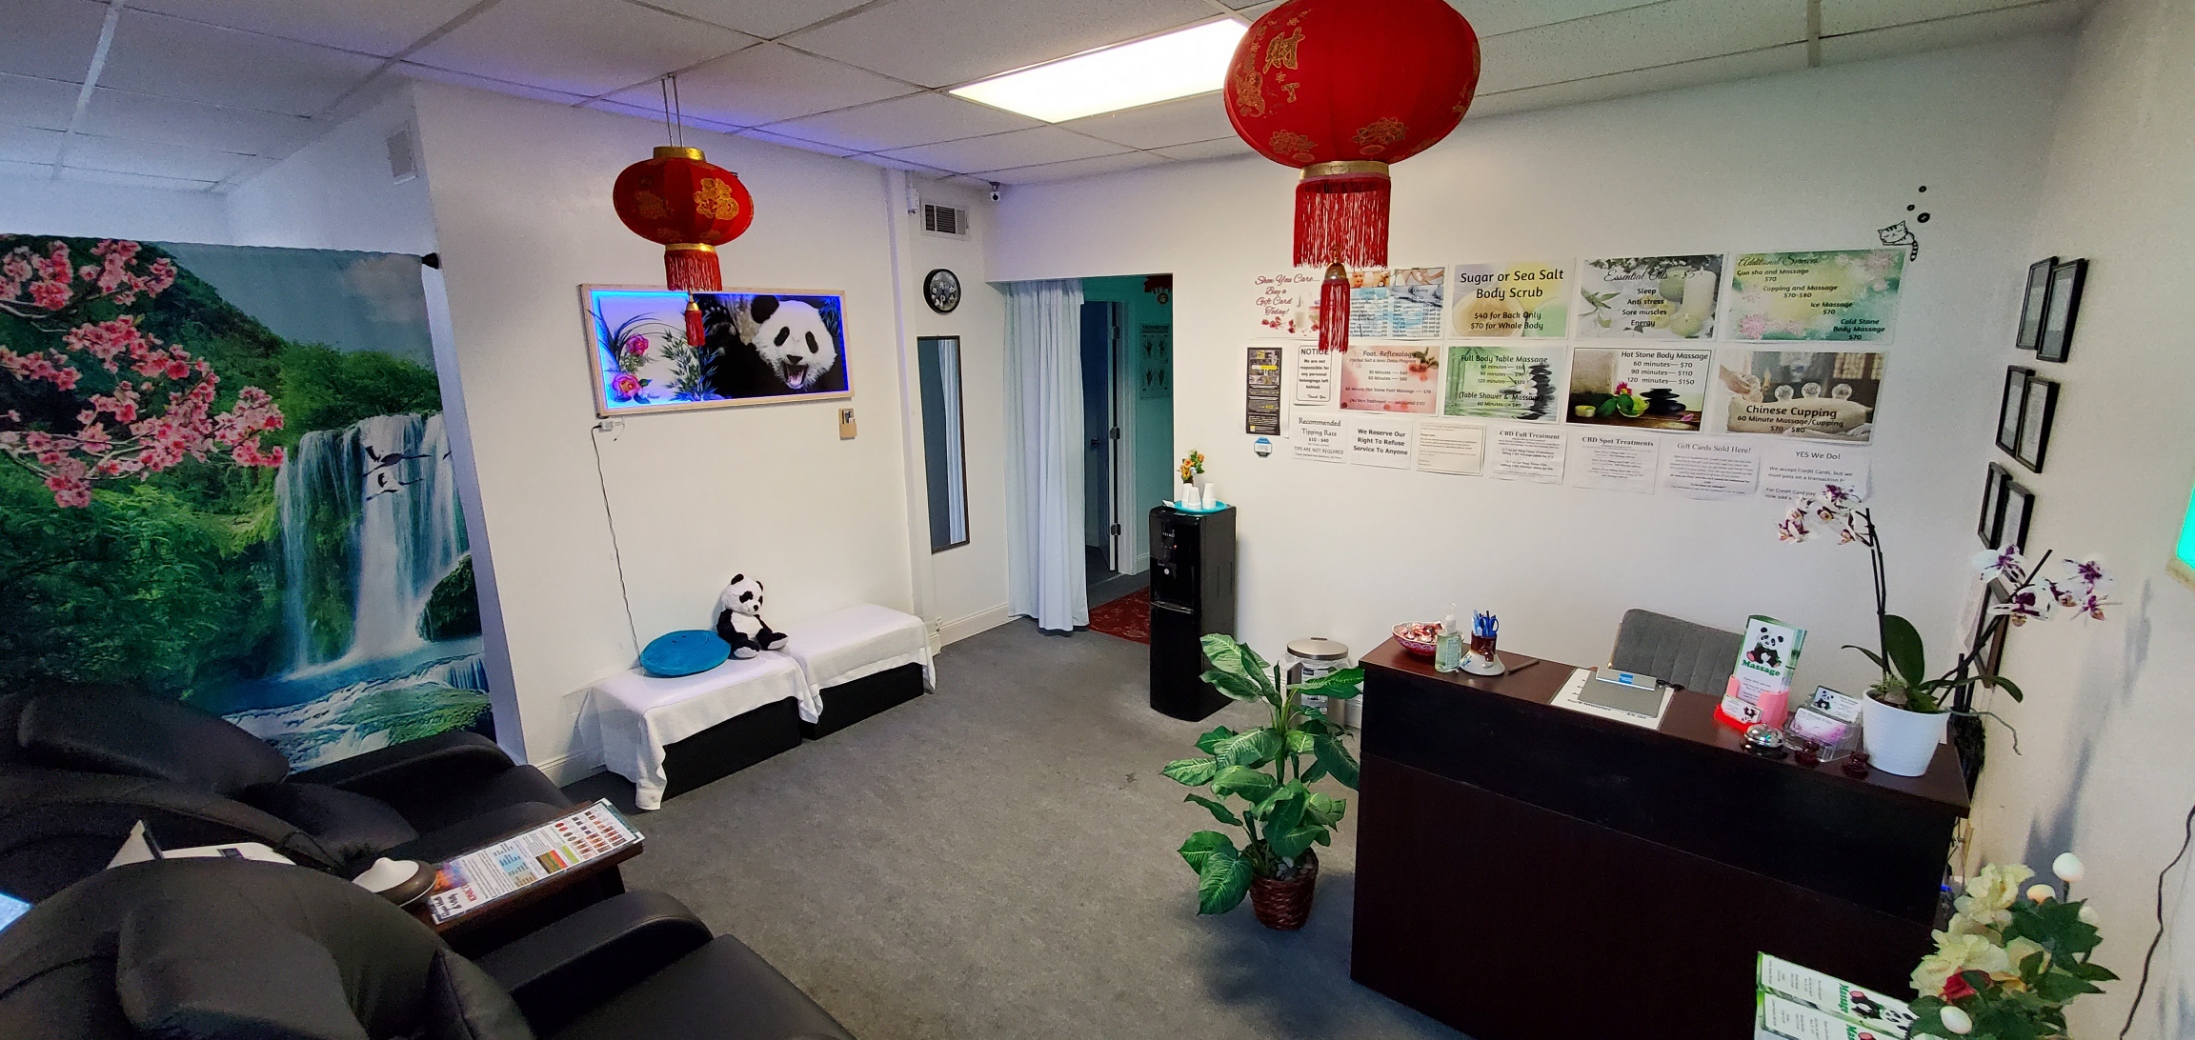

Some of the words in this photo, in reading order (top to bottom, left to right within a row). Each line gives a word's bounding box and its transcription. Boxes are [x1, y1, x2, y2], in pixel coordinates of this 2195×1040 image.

[1460, 273, 1494, 285] Sugar
[1498, 273, 1510, 281] or
[1514, 271, 1535, 280] Sea
[1539, 268, 1564, 280] Salt
[1604, 266, 1648, 281] Essential
[1648, 267, 1668, 280] Oils
[1255, 276, 1274, 285] Show
[1276, 274, 1292, 286] You
[1265, 286, 1281, 296] Buy
[1476, 288, 1505, 301] Body
[1509, 287, 1543, 298] Scrub
[1256, 297, 1271, 307] Gift
[1273, 296, 1293, 305] Card
[1265, 306, 1290, 316] Today!
[1490, 312, 1500, 320] for
[1523, 311, 1541, 320] Only
[1471, 322, 1484, 330] $70
[1486, 322, 1496, 330] for
[1524, 322, 1543, 330] Body
[1631, 320, 1655, 328] Energy
[1476, 355, 1493, 363] Body
[1516, 356, 1548, 364] Massage
[1657, 352, 1674, 360] Body
[1746, 405, 1787, 415] Chinese
[1791, 407, 1837, 419] Cupping
[1299, 417, 1341, 426] Recommended
[1776, 417, 1844, 428] Massage/Cupping
[1302, 428, 1322, 436] Tipping
[1385, 448, 1408, 456] Anyone
[1742, 659, 1780, 676] Massage
[1838, 983, 1849, 1013] Massage
